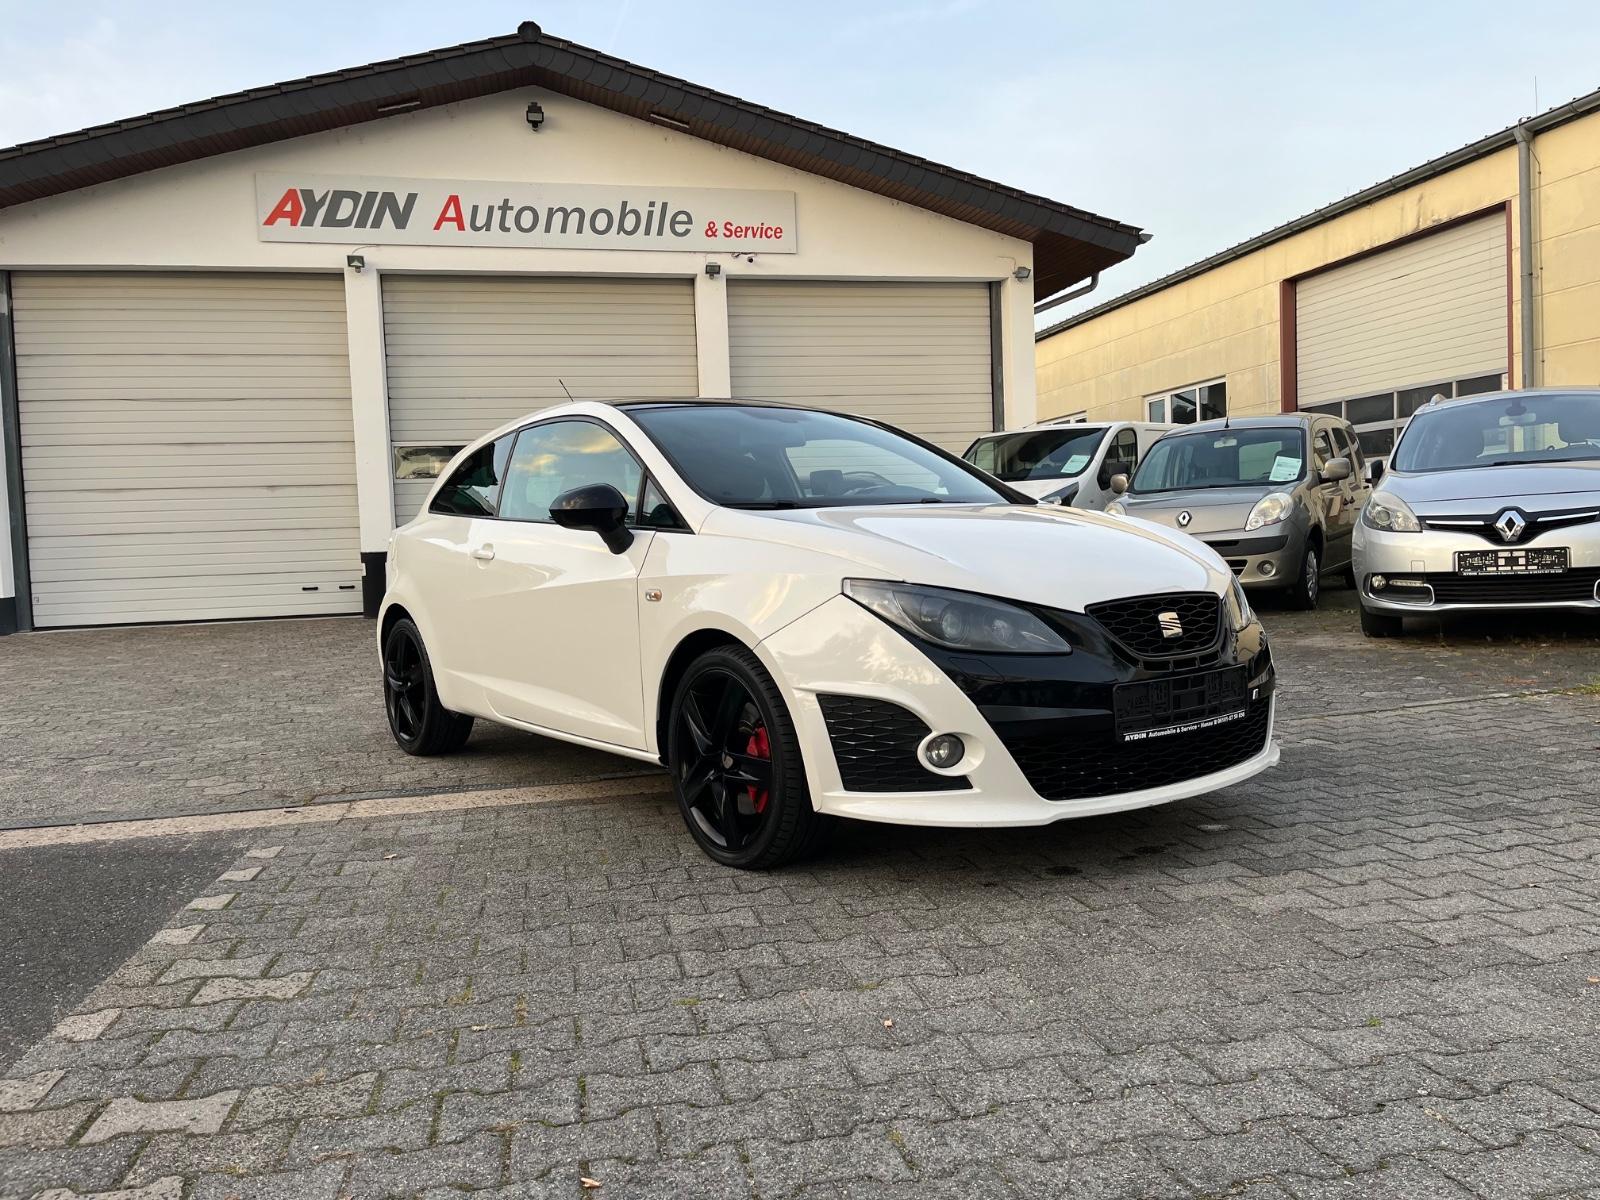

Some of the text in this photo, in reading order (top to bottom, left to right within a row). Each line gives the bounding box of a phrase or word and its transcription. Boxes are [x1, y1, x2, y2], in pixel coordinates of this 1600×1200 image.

[262, 188, 783, 239] AYDIN Automobile & Service
[1124, 732, 1146, 742] AYDIN
[1148, 728, 1176, 738] Automobile
